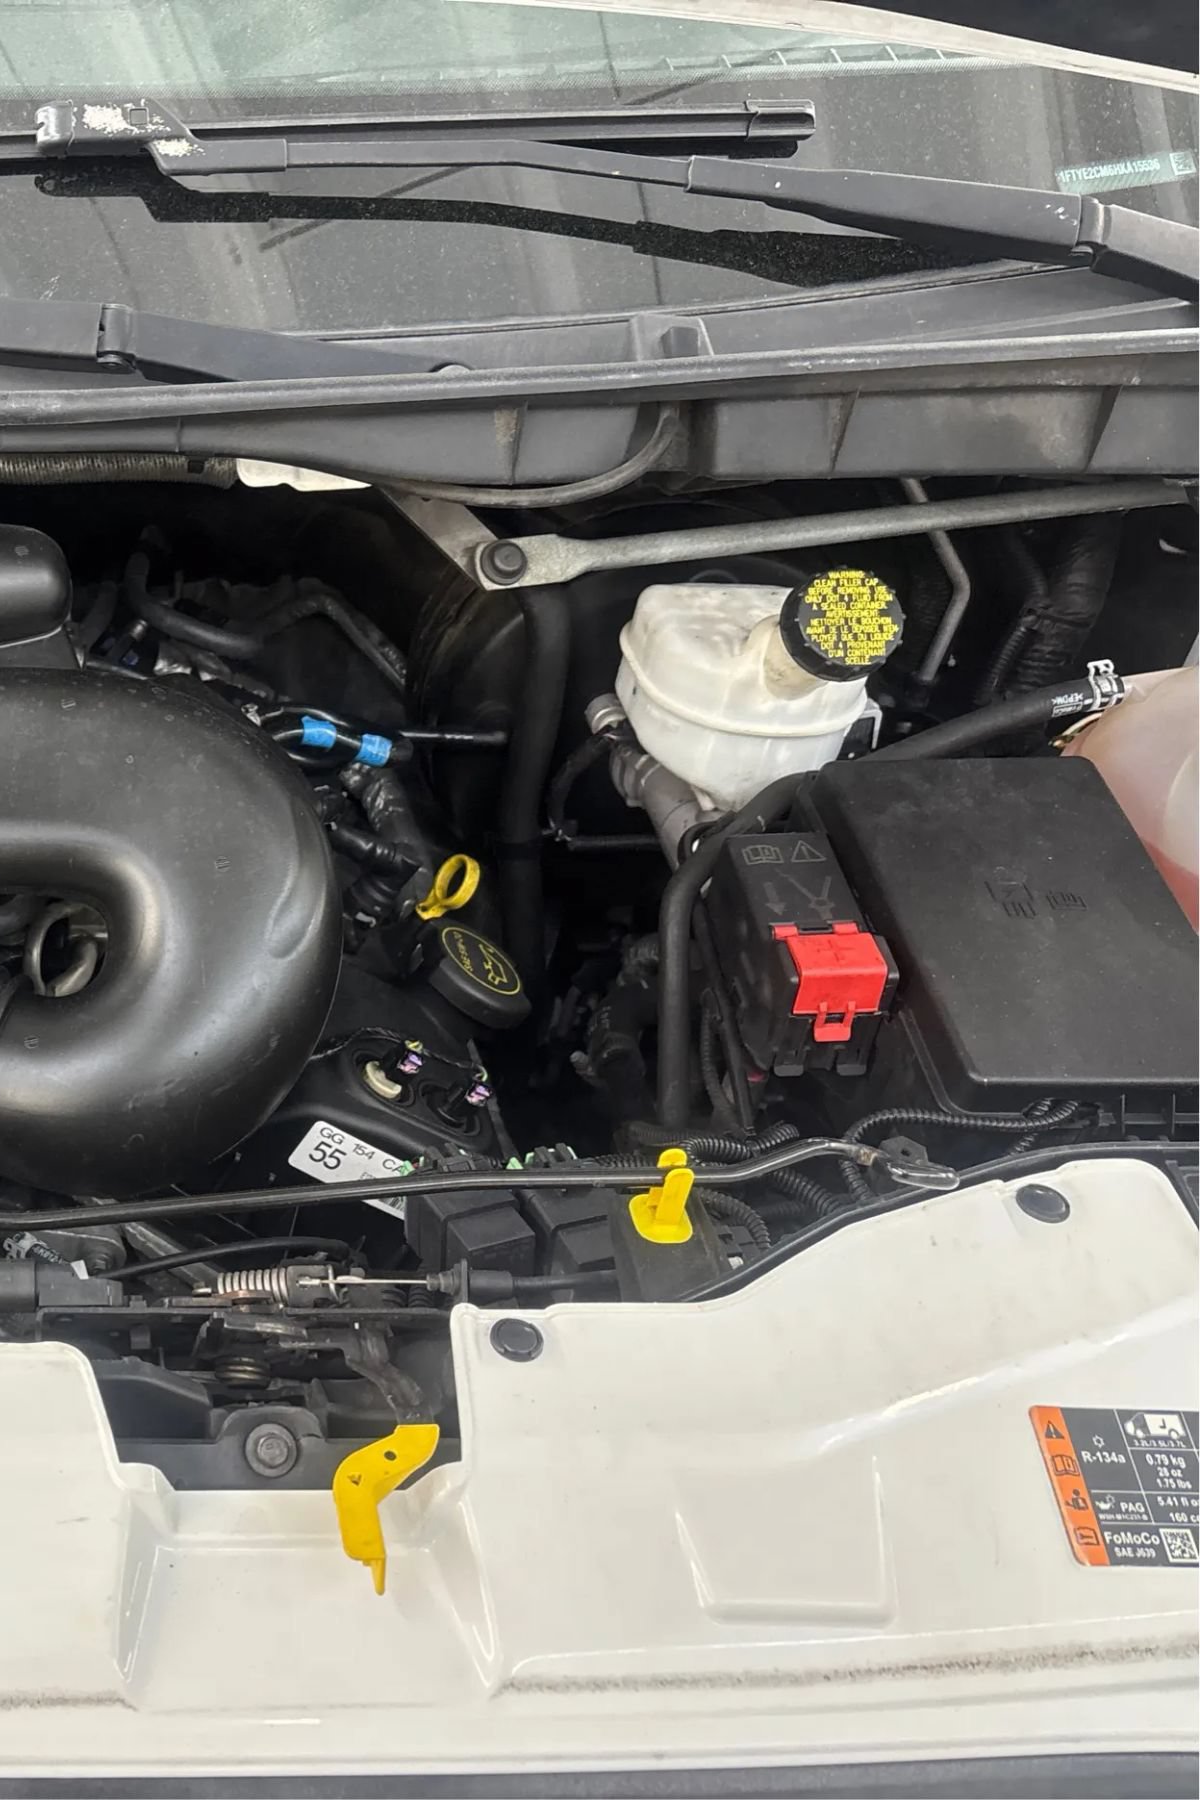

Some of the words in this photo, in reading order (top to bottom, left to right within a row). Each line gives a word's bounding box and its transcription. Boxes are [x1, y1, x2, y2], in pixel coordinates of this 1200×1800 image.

[814, 579, 837, 587] CLEAN
[840, 578, 862, 586] FILLER
[865, 578, 879, 586] CAP
[808, 587, 833, 595] BEFORE
[805, 595, 822, 603] ONLY
[852, 593, 870, 601] FLUID
[874, 593, 893, 601] FROM
[821, 602, 846, 610] SEALED
[810, 618, 845, 626] NETTOYER
[848, 617, 857, 625] LE
[861, 617, 892, 625] BOUCHON
[829, 625, 837, 633] DE
[840, 625, 849, 633] LE
[811, 633, 837, 642] PLOYER
[841, 633, 854, 641] QUE
[858, 632, 867, 640] DU
[821, 641, 834, 649] DOT
[847, 647, 886, 657] CONTENANT
[320, 1127, 345, 1145] GG
[352, 1143, 375, 1160] 154
[308, 1141, 347, 1170] 55
[1081, 1450, 1126, 1463] R-134a
[1145, 1453, 1169, 1466] 0.79
[1169, 1453, 1186, 1469] kg
[1157, 1466, 1170, 1477] 28
[1171, 1468, 1183, 1478] oz
[1156, 1478, 1176, 1489] 1.75
[1176, 1478, 1192, 1489] lbs
[1157, 1495, 1179, 1507] 5.41
[1120, 1501, 1145, 1513] PAG
[1169, 1512, 1188, 1523] 160
[1103, 1531, 1160, 1545] FoMoCo
[1114, 1546, 1135, 1558] SAE
